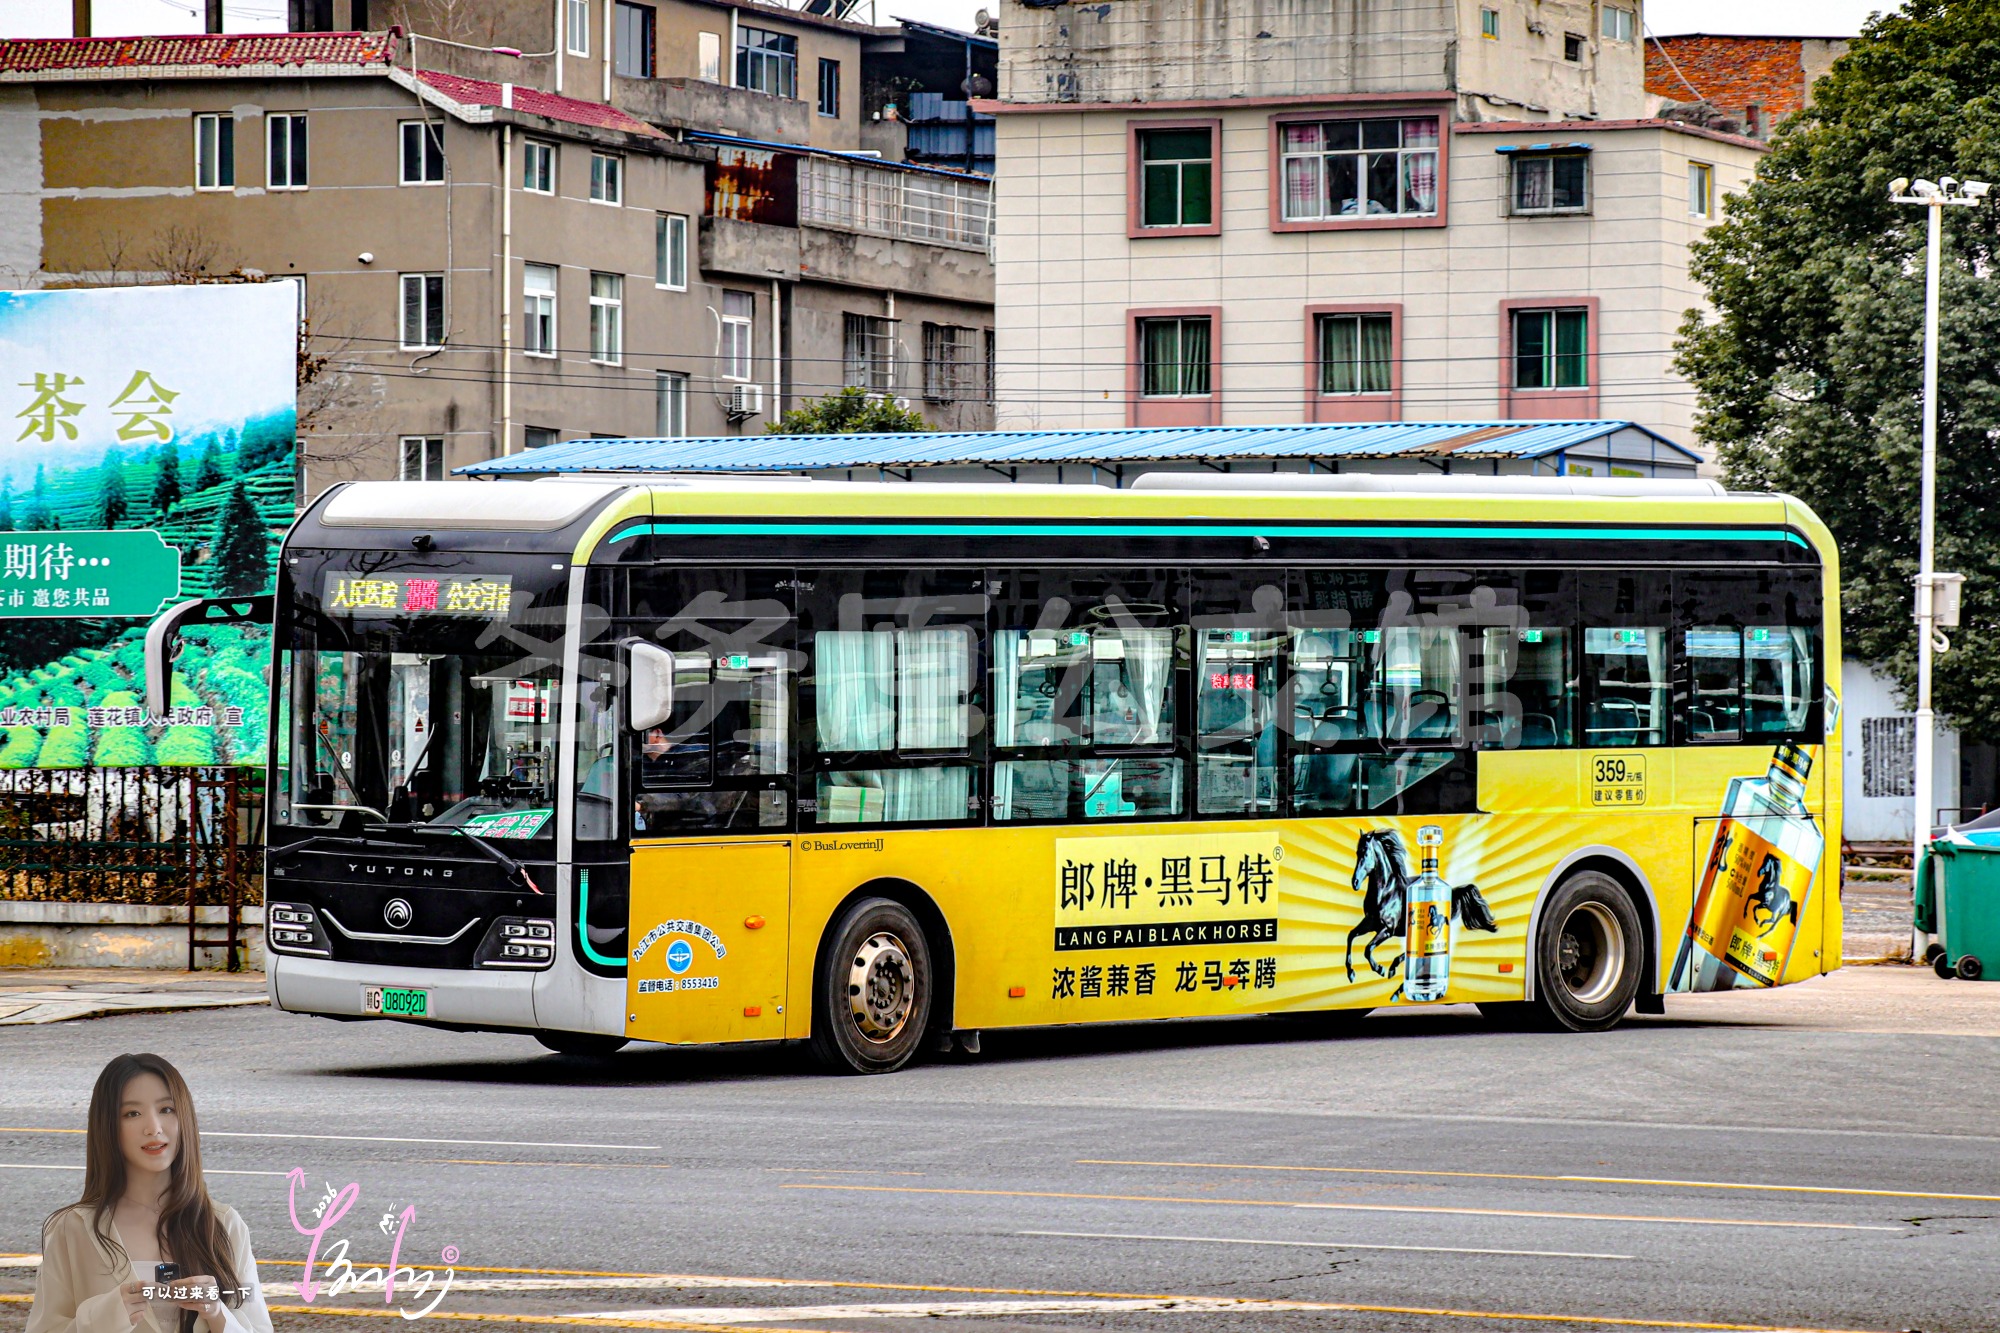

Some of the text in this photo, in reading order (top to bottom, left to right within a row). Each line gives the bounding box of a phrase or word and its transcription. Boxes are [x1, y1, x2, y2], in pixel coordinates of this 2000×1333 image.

[15, 369, 181, 443] 茶会
[32, 587, 110, 608] 邀您共品
[330, 579, 399, 609] 人民医院
[88, 706, 213, 728] 莲花镇人民政府
[225, 706, 244, 728] 宣
[1594, 788, 1644, 802] 建议零售价
[348, 863, 454, 878] YUTONG
[1060, 852, 1274, 912] 郎牌·黑马特
[632, 919, 727, 962] 九江市公共交通集团公司
[1058, 923, 1274, 946] LANG PAI BLACK HORSE
[1051, 957, 1277, 1000] 浓酱兼香 龙马奔腾
